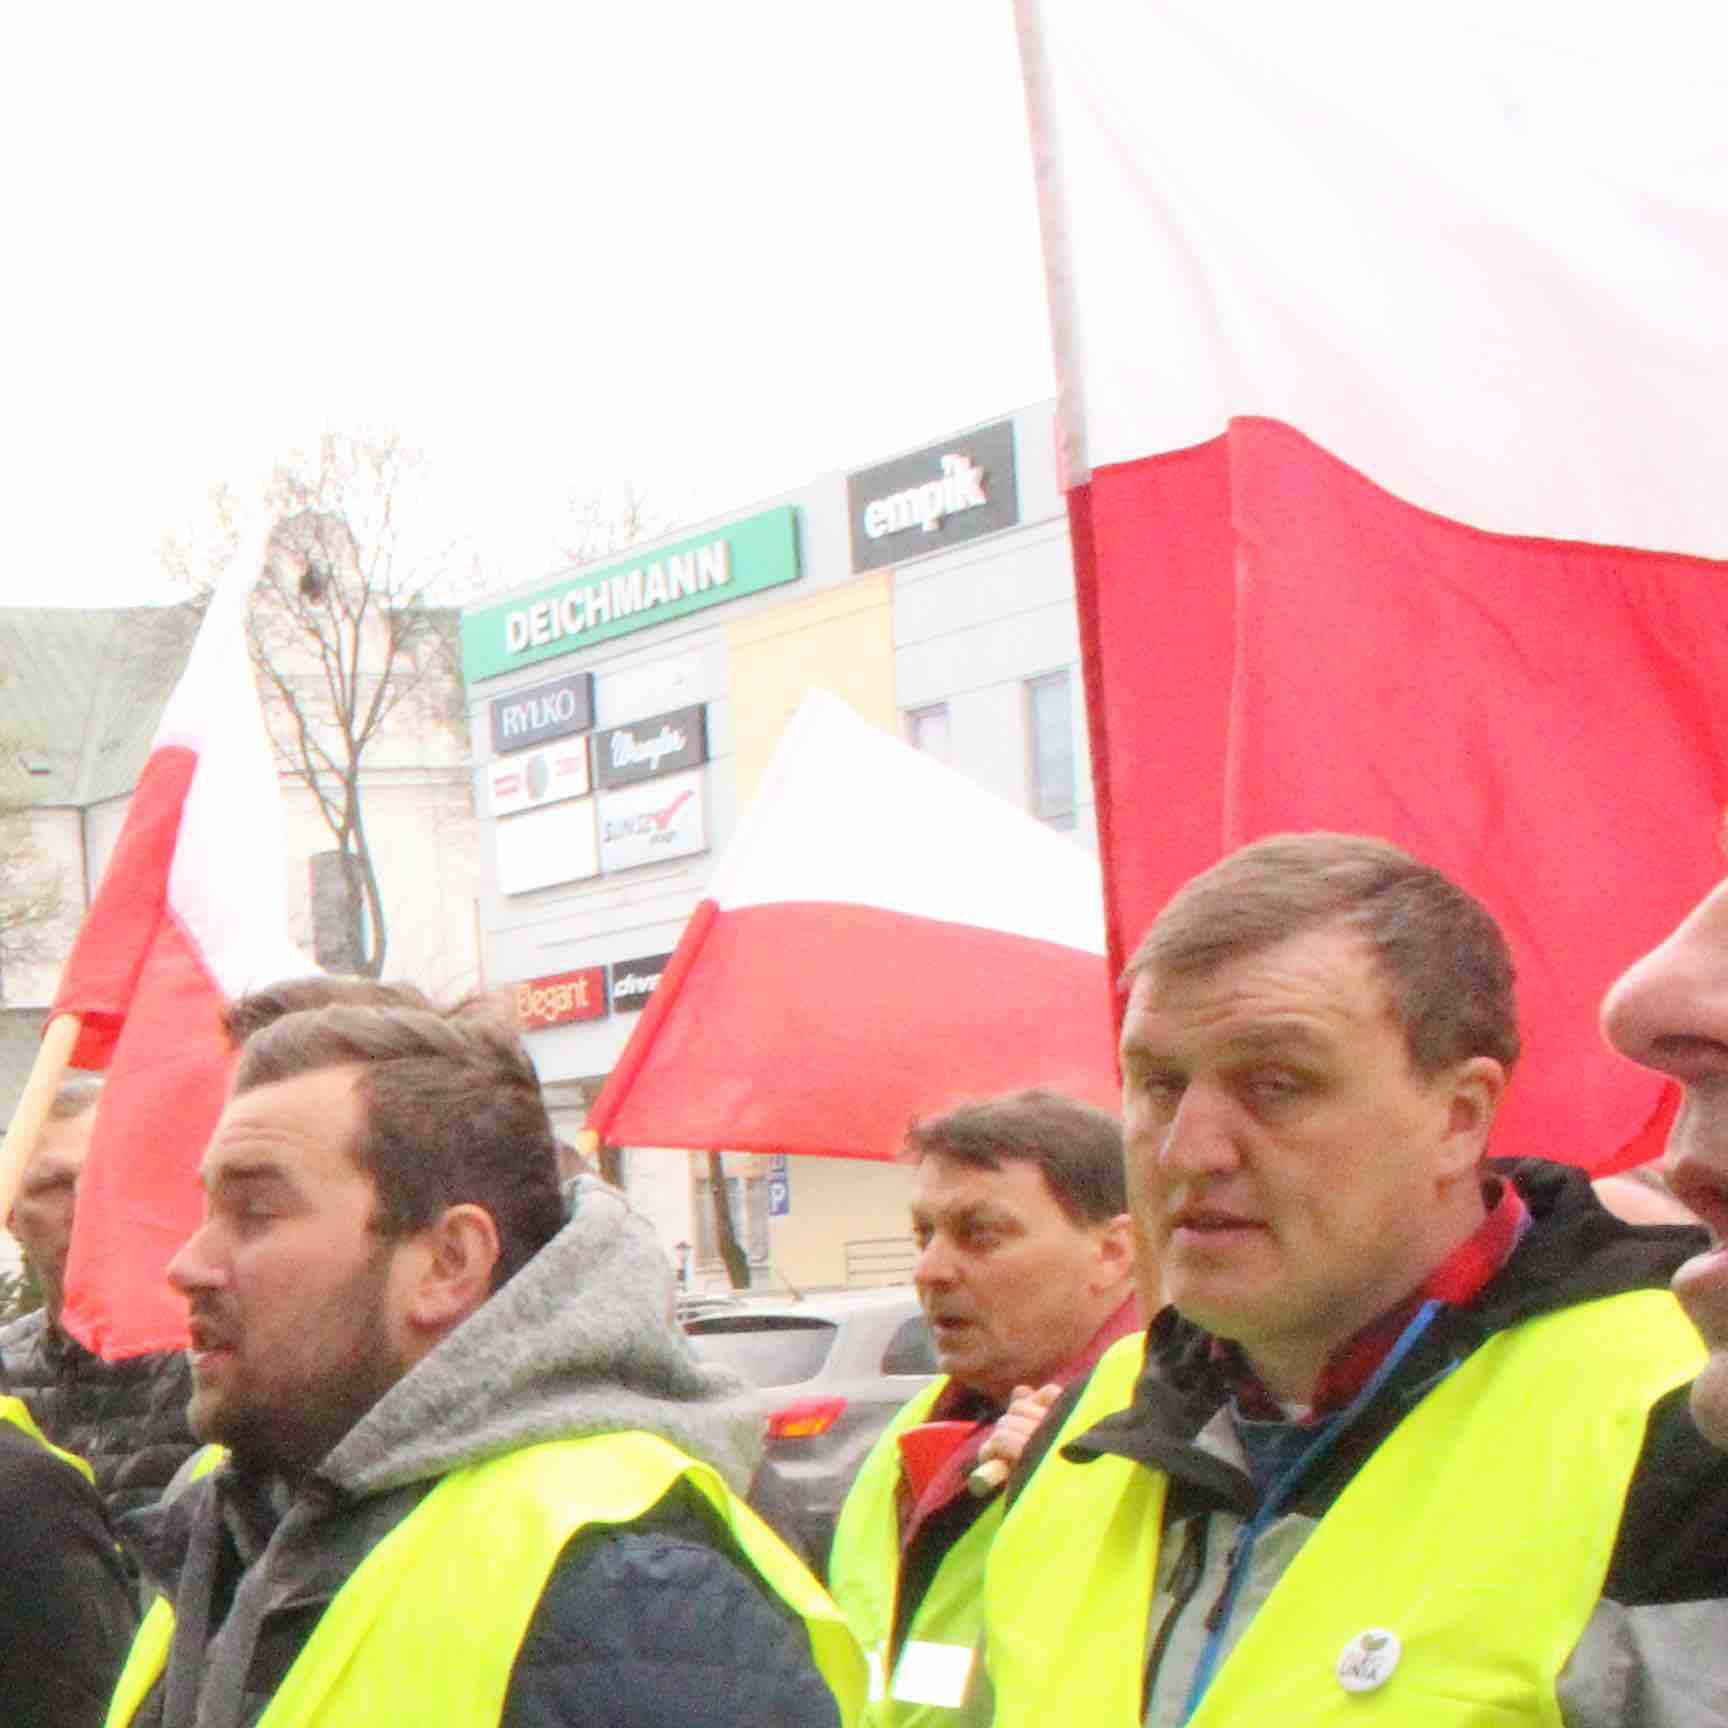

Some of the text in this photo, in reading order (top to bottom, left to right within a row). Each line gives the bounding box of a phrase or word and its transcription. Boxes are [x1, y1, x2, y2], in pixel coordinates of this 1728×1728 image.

[863, 452, 988, 540] empik
[504, 538, 731, 655] DEICHMANN
[518, 975, 590, 1022] Elegant
